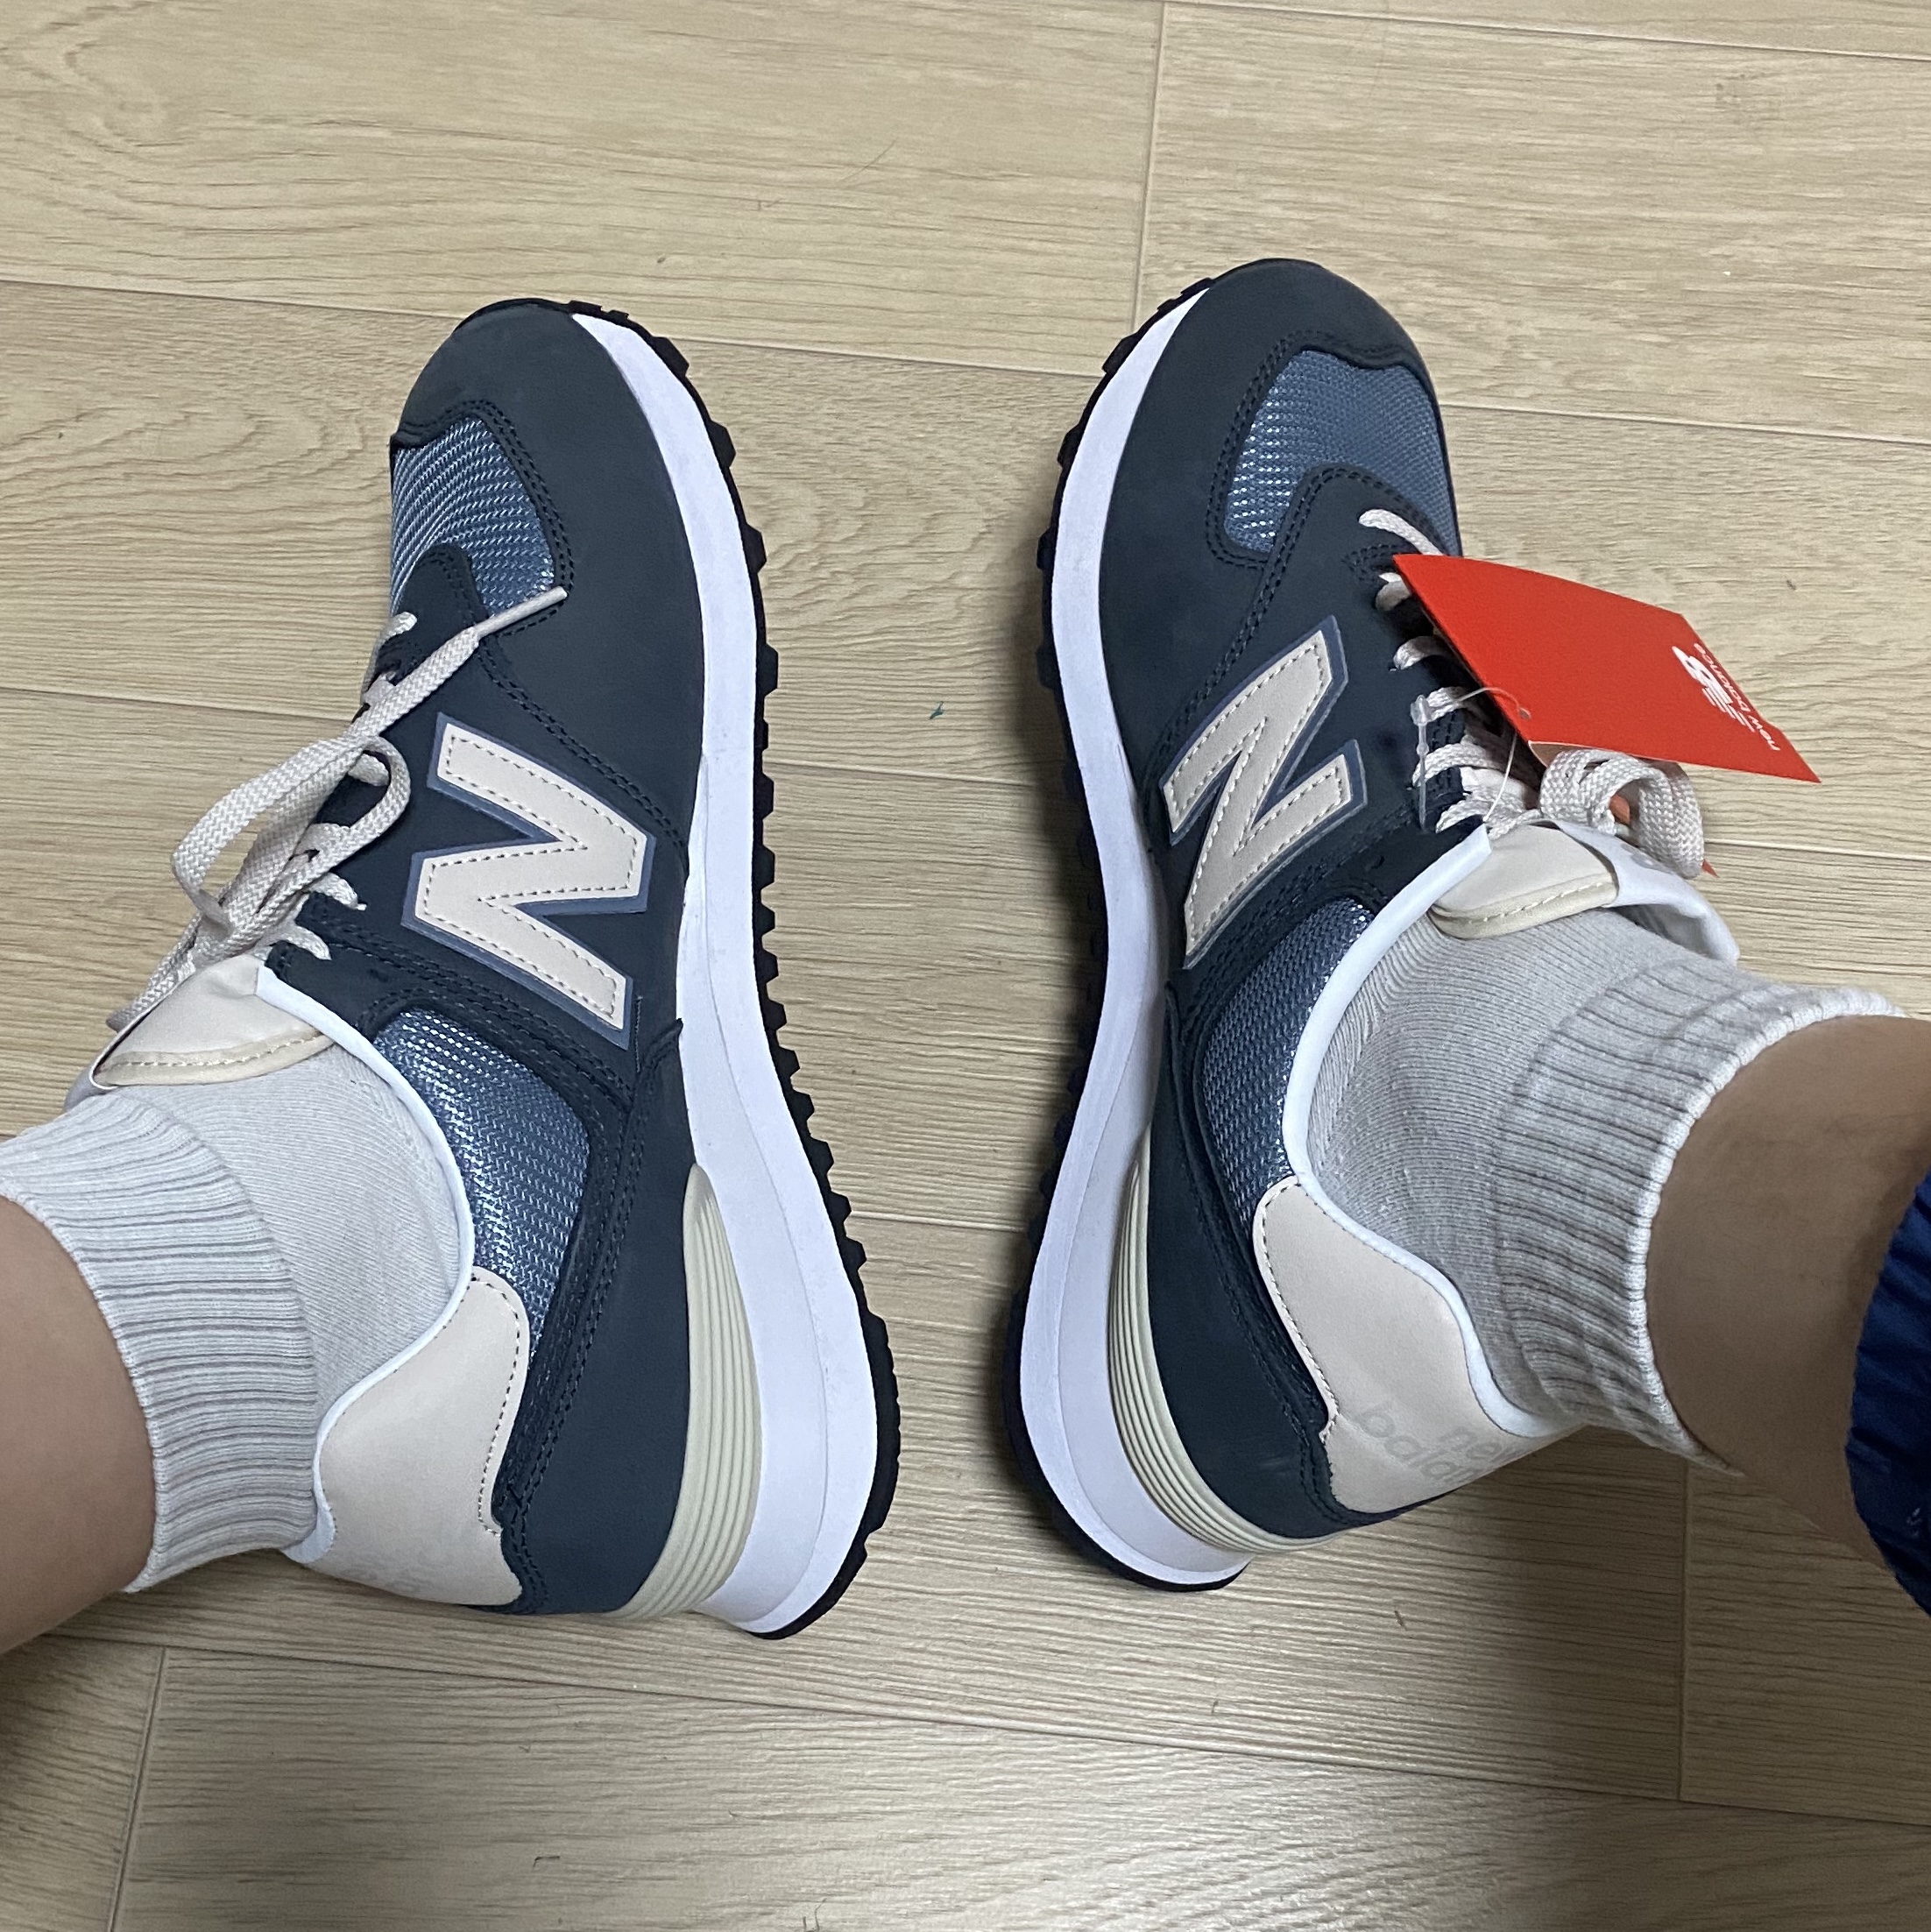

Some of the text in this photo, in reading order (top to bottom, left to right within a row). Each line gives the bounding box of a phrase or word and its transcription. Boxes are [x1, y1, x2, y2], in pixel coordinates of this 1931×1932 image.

[1162, 626, 1355, 958] N
[1693, 641, 1781, 752] new balance
[412, 721, 649, 1035] N
